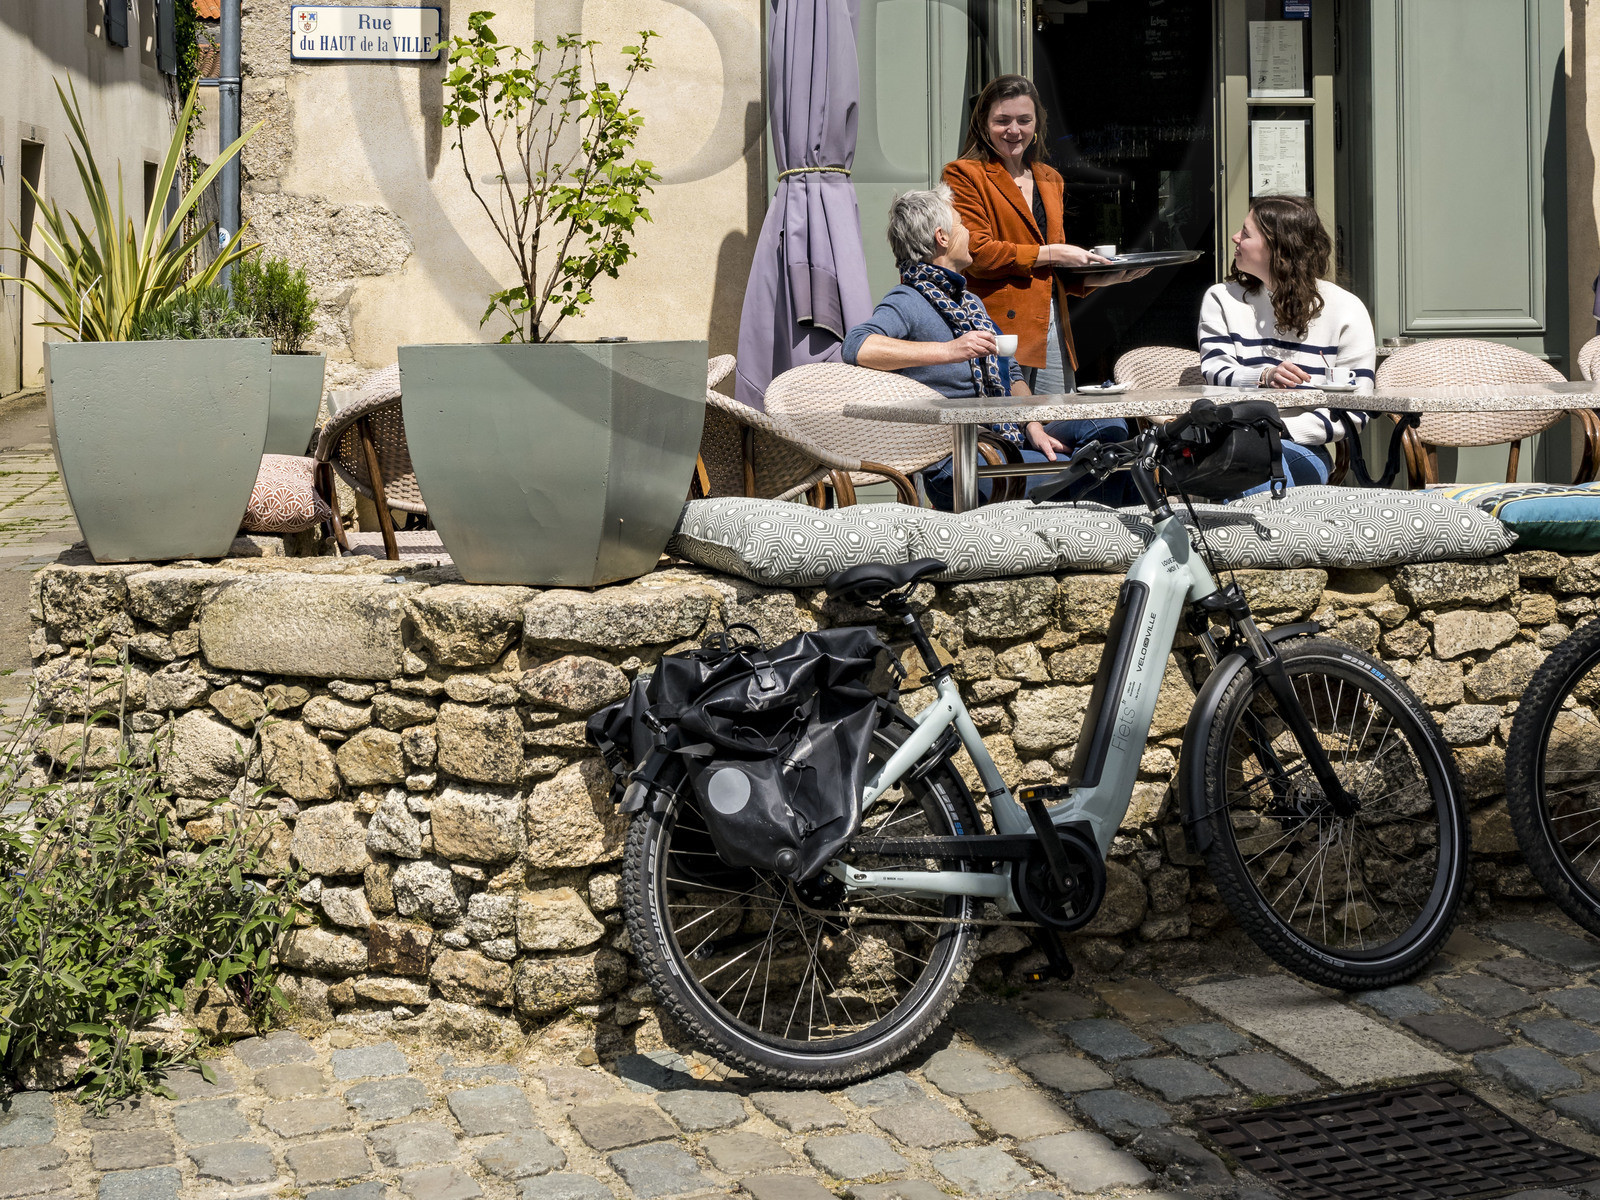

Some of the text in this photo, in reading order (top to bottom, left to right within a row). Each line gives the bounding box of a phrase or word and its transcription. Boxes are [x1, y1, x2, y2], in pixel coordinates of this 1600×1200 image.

[358, 13, 392, 31] Rue
[299, 35, 432, 53] du HAUT de la VILLE
[1111, 706, 1136, 752] Fiets
[648, 839, 679, 976] SCHWALBE
